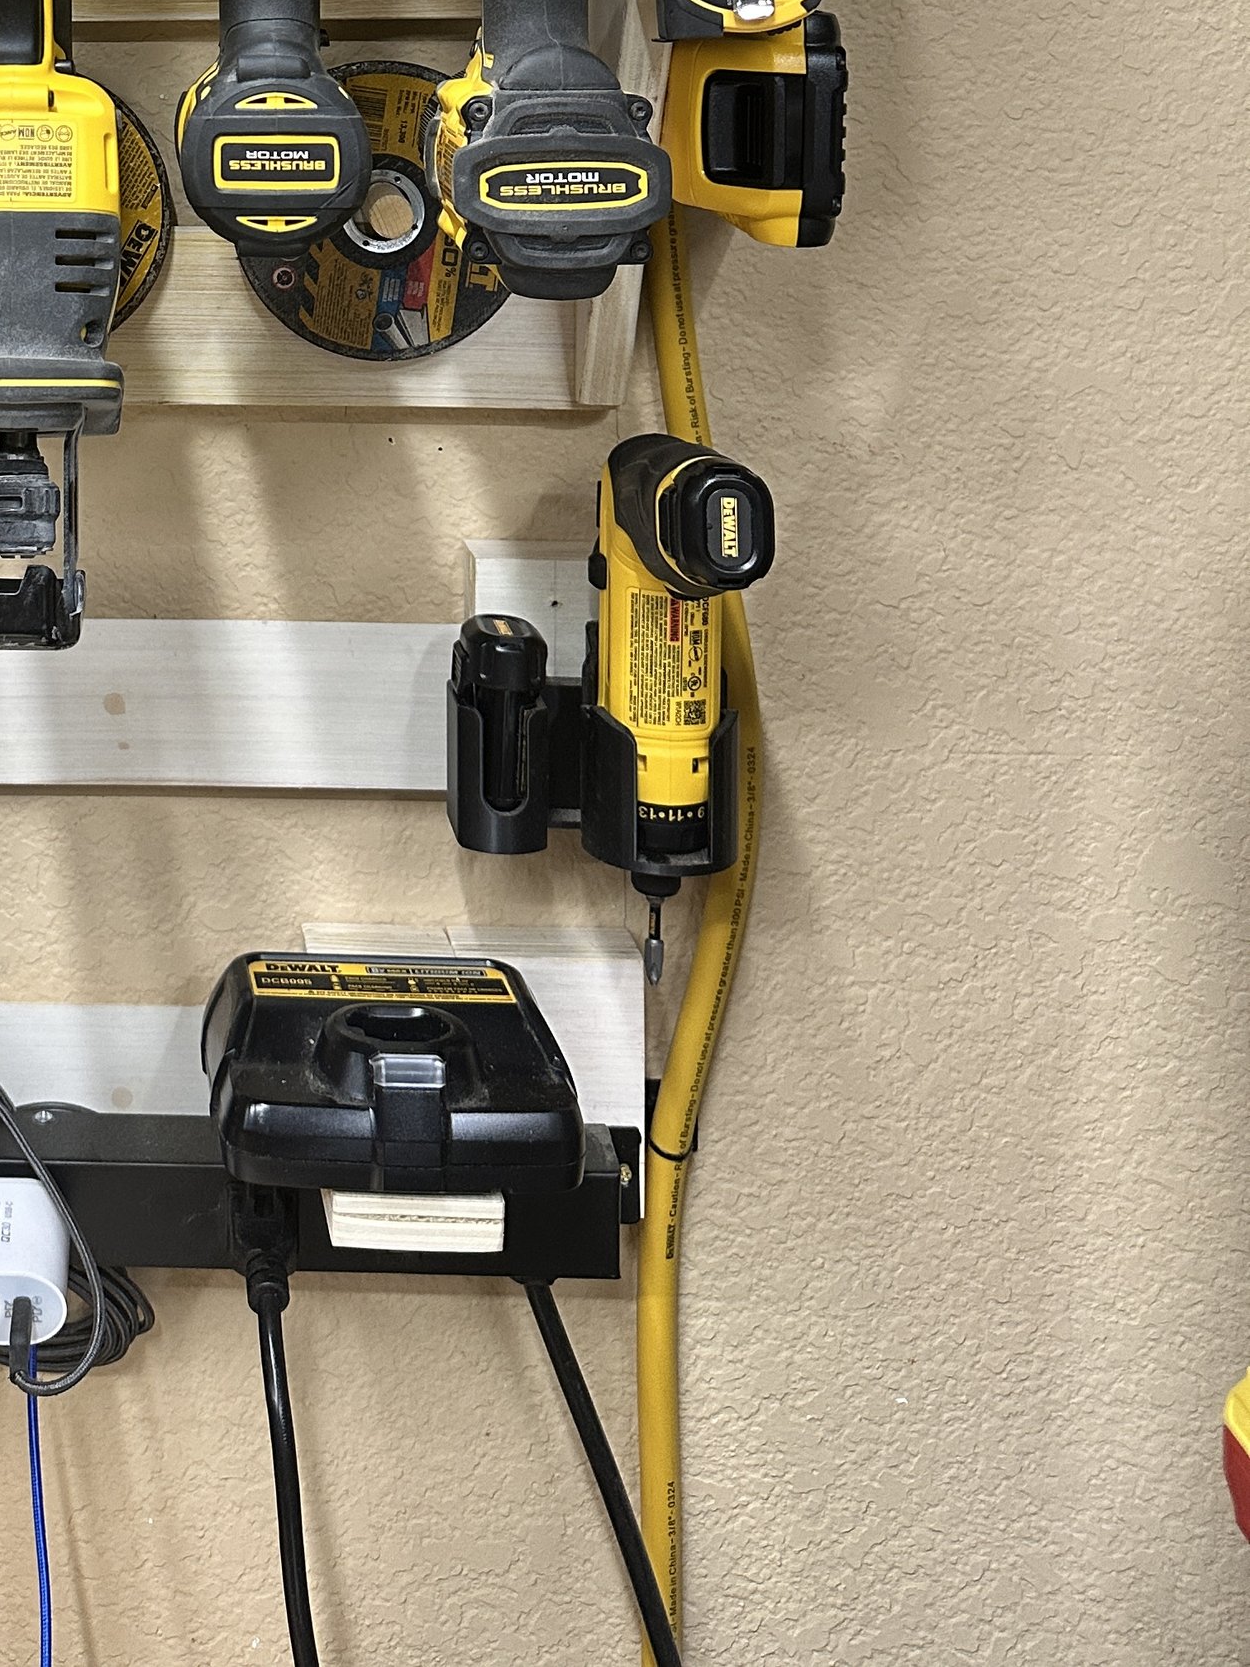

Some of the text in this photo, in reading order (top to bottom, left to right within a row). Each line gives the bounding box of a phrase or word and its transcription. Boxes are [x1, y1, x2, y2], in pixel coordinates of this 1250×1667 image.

[228, 160, 326, 171] BRUSHLESS
[245, 150, 309, 160] MOTOR
[499, 183, 627, 197] BRUSHLESS
[525, 172, 600, 184] MOTOR
[669, 238, 684, 282] pressure
[681, 352, 695, 393] Bursting
[690, 406, 701, 430] Risk
[721, 497, 738, 557] DEWALT
[670, 605, 681, 642] WARNING
[746, 746, 757, 774] 0324
[744, 810, 756, 842] China
[738, 853, 751, 882] Made
[734, 888, 746, 907] PSI
[730, 907, 743, 927] 300
[725, 928, 739, 950] than
[265, 962, 339, 974] DEWALT
[715, 950, 732, 988] greater
[706, 988, 723, 1031] pressure
[680, 1099, 697, 1137] Bursting
[669, 1177, 681, 1218] Caution
[667, 1481, 676, 1509] 0324
[668, 1544, 678, 1575] China
[668, 1590, 678, 1617] Made
